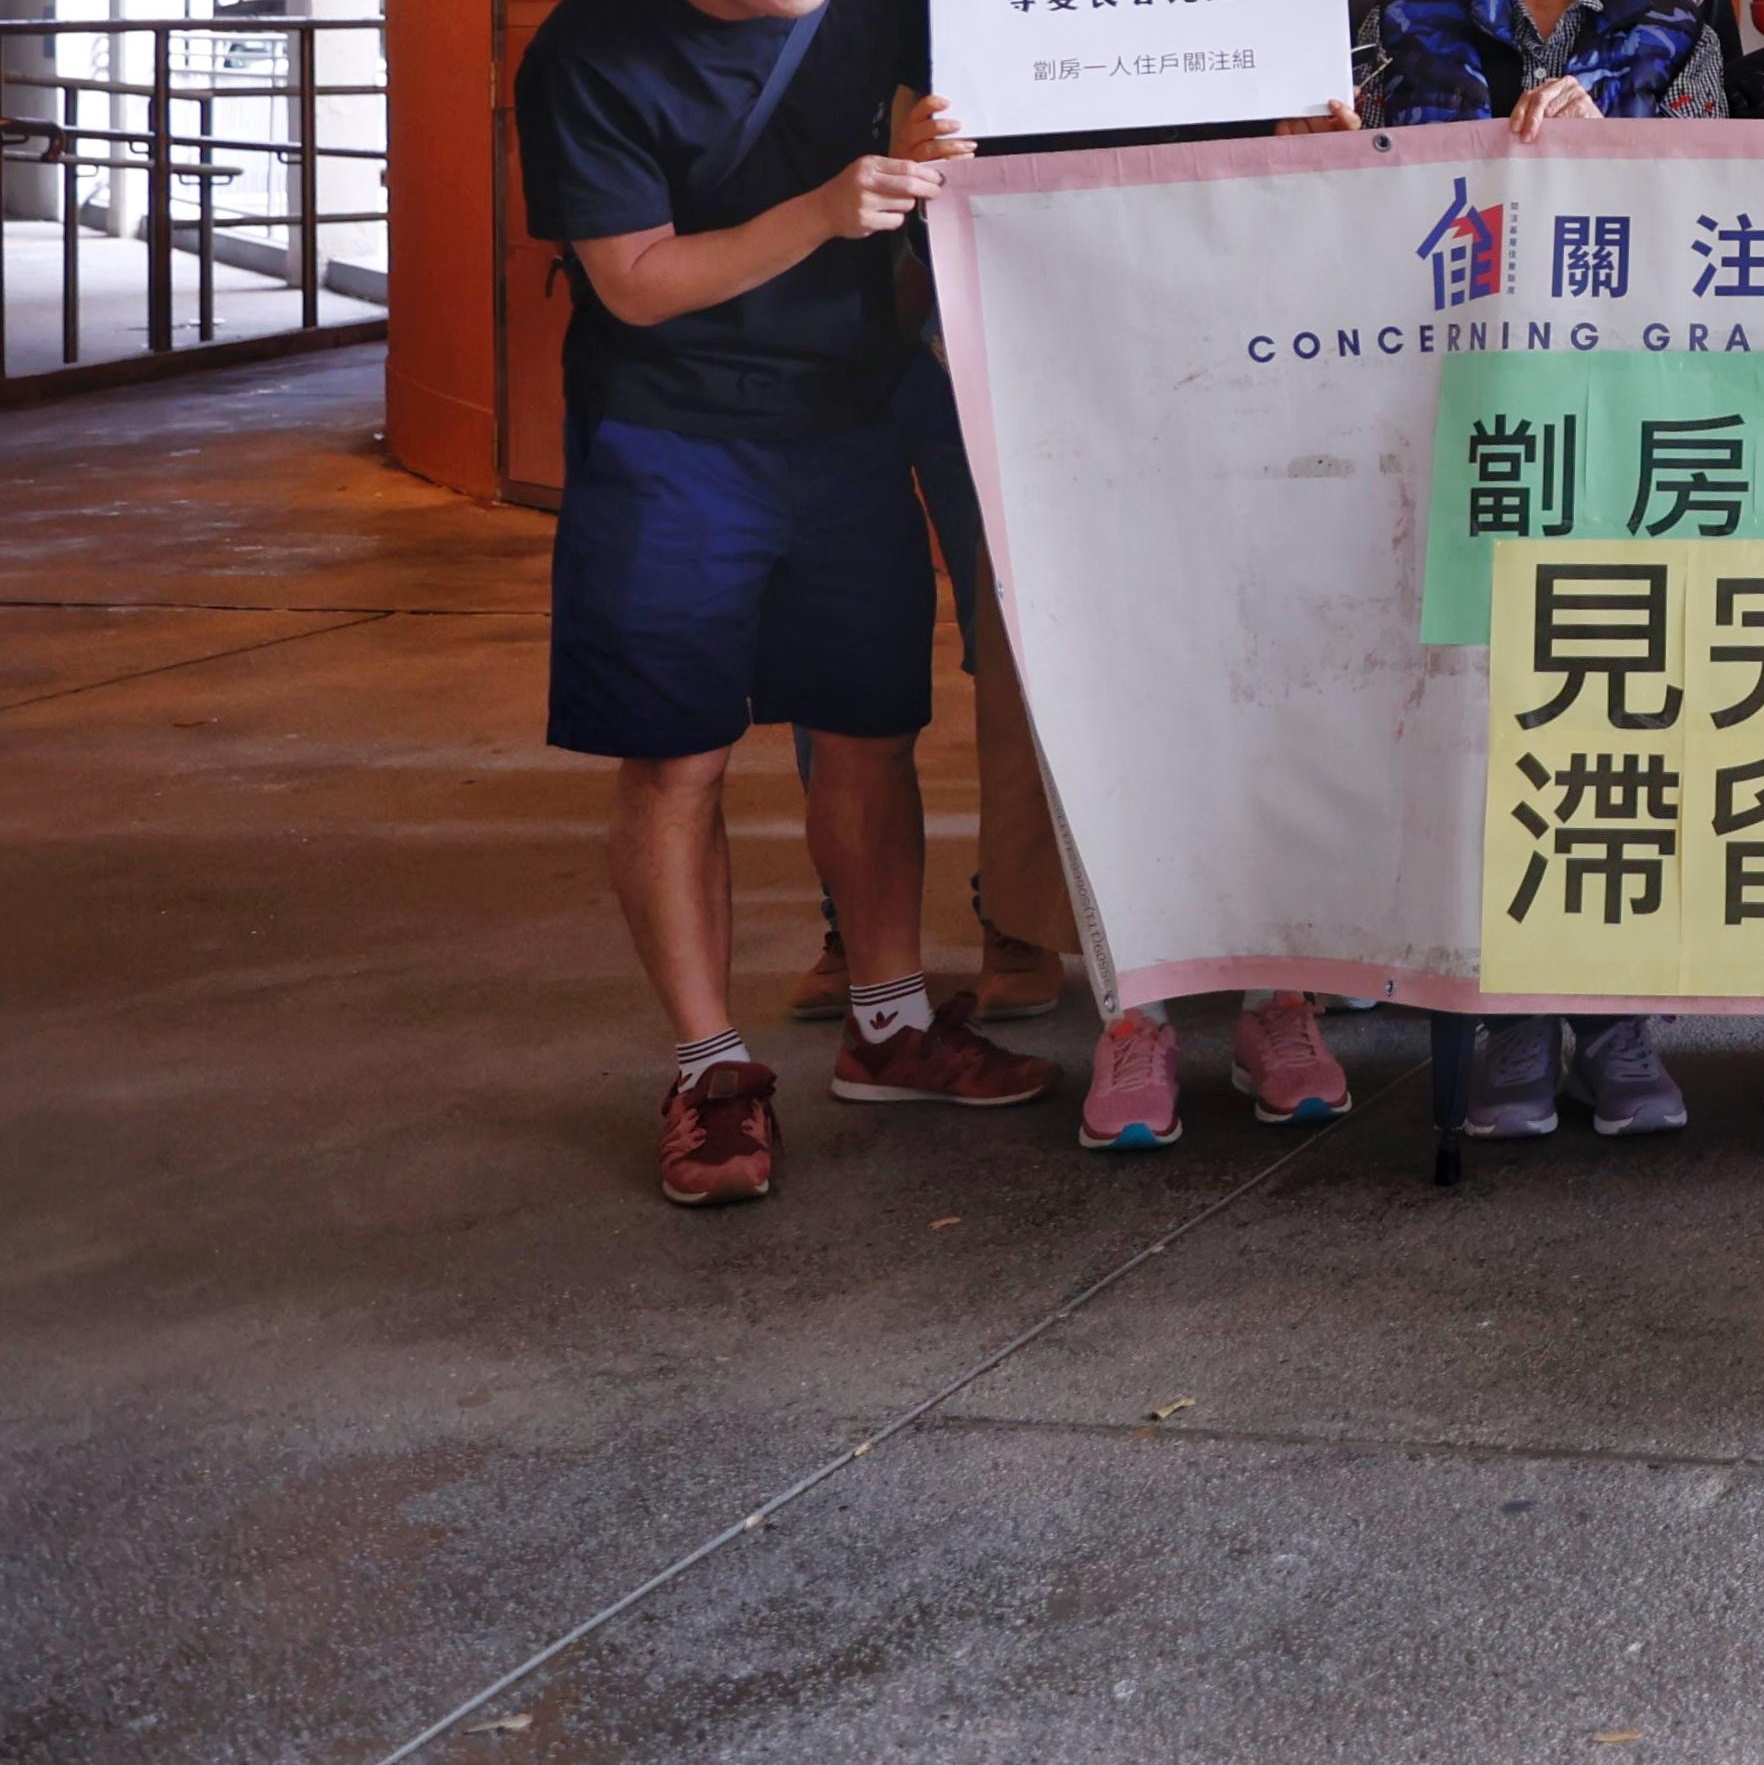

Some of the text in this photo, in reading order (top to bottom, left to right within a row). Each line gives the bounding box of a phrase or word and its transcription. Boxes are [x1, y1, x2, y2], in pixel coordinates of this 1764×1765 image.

[1033, 48, 1256, 81] 劏房一人住戶關注組
[1248, 322, 1600, 364] CONCERNING
